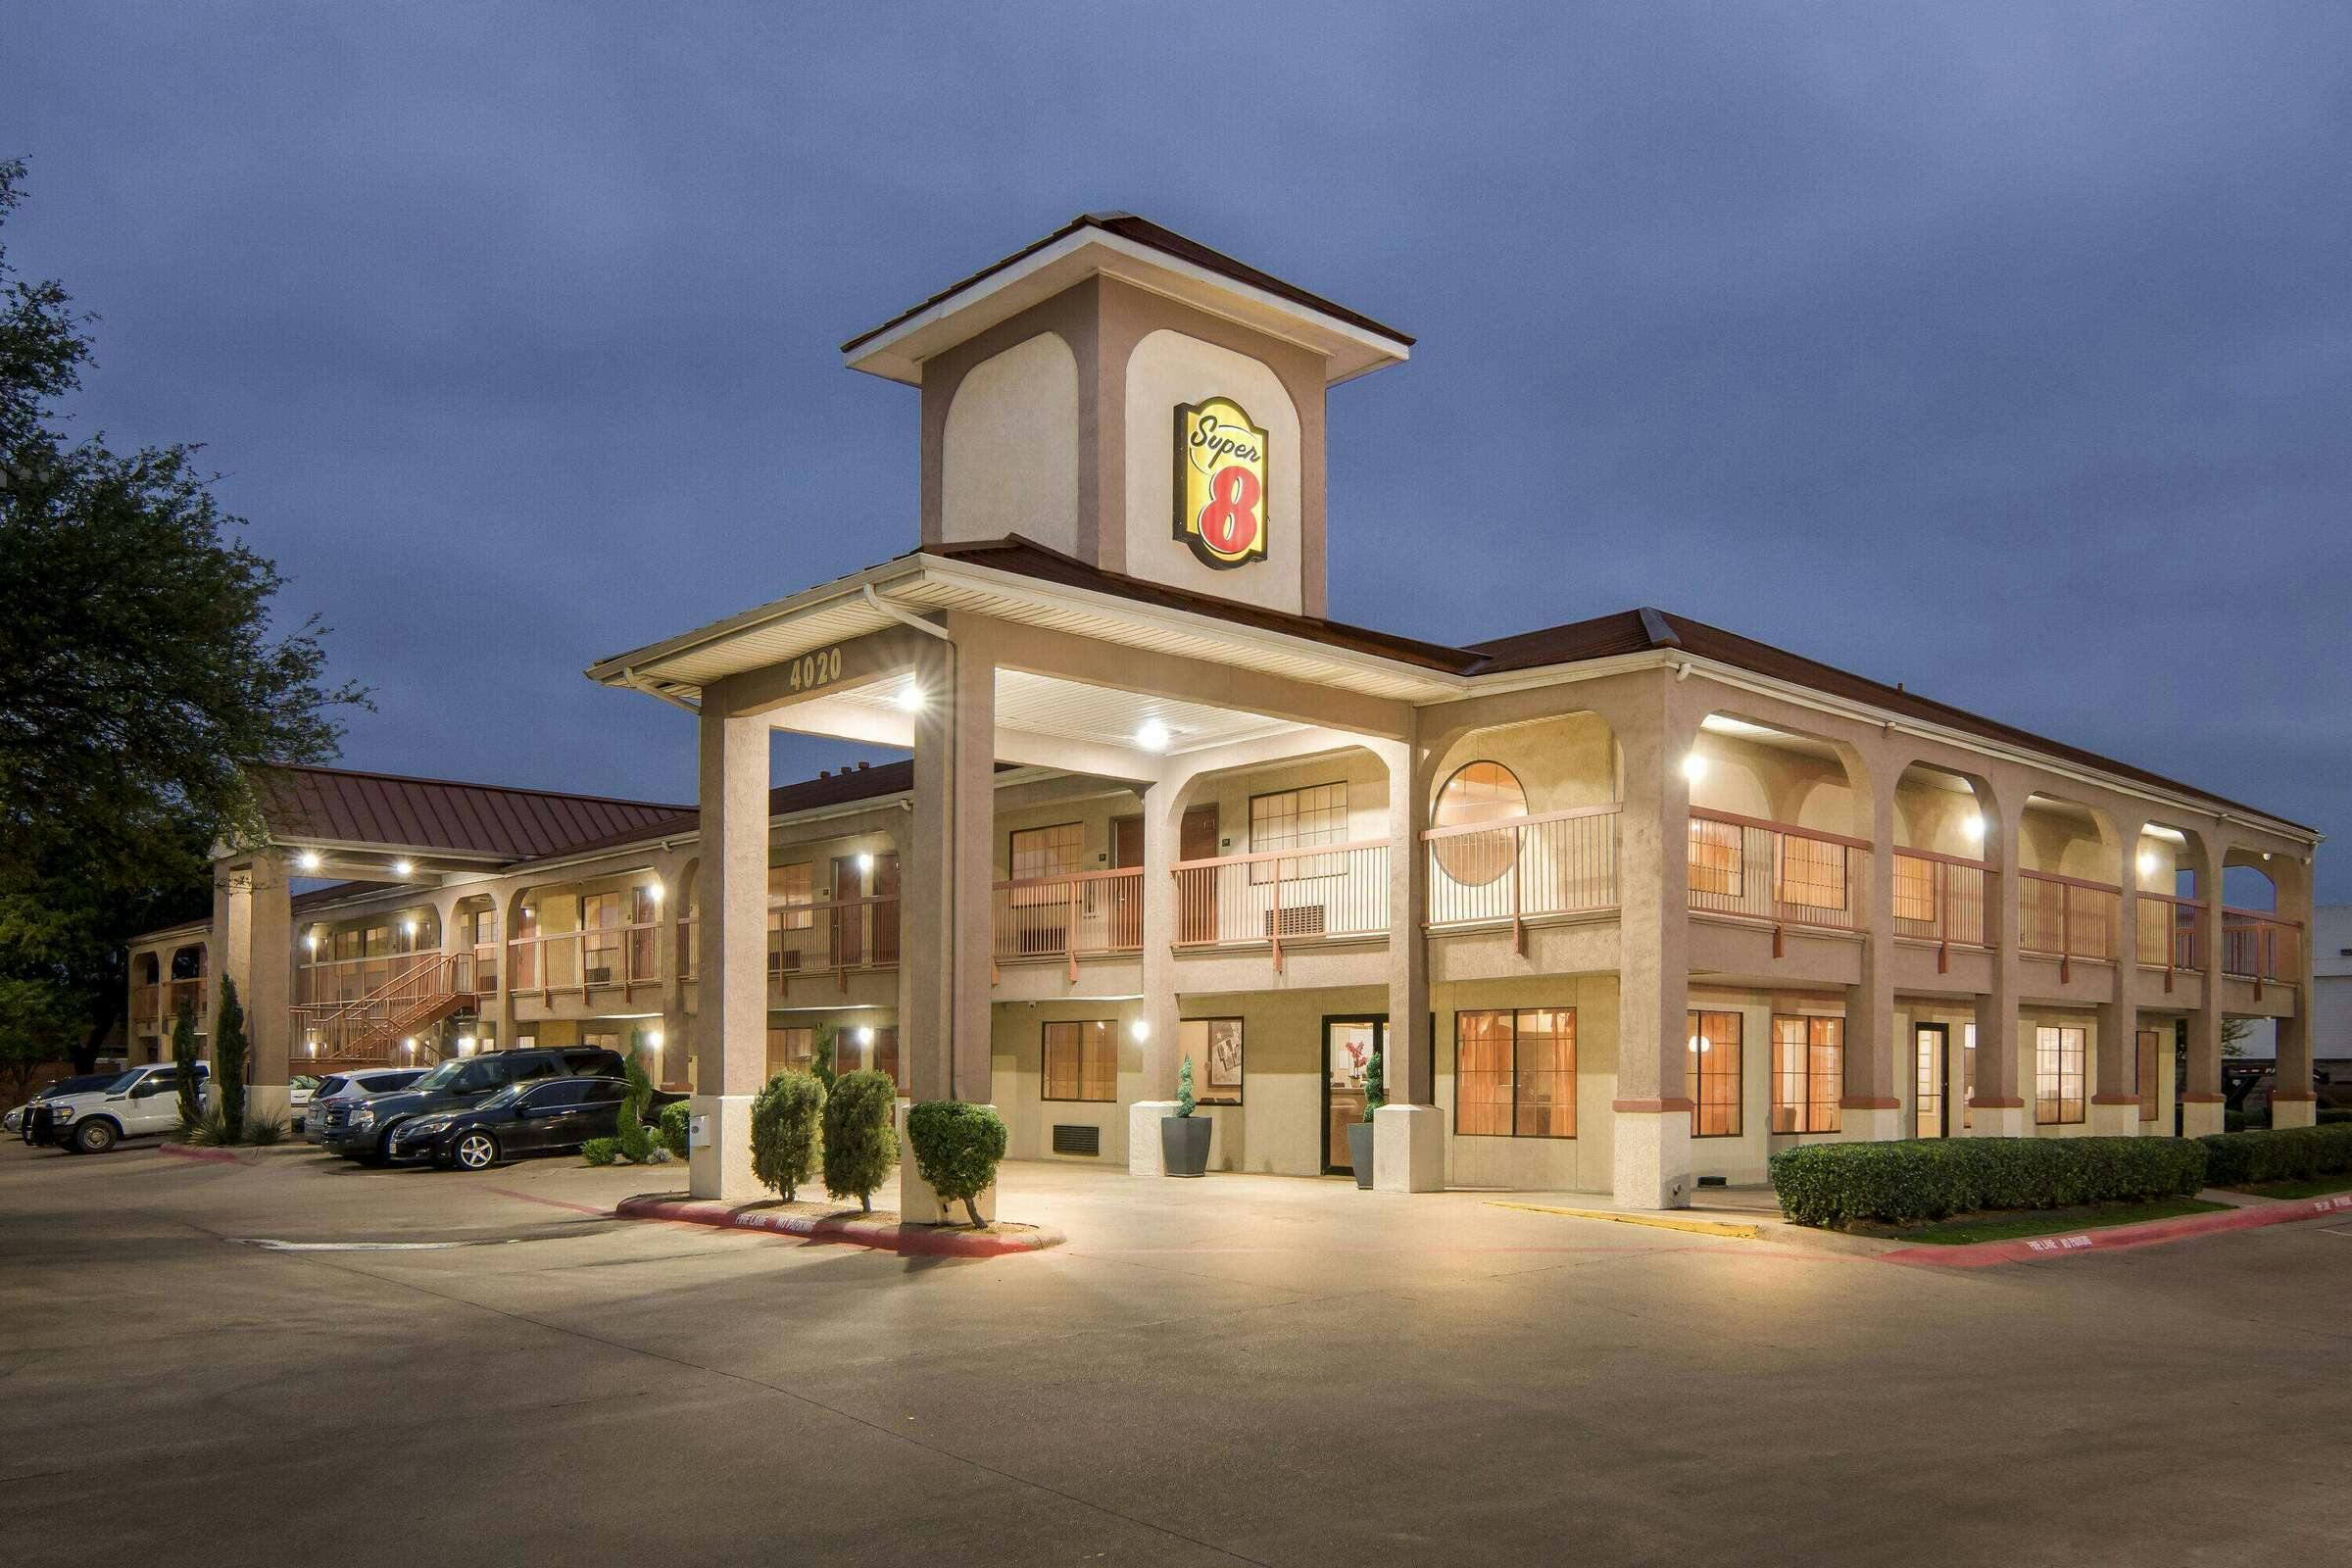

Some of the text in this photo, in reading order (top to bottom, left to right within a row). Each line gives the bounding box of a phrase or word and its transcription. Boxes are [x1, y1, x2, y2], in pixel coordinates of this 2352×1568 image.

[1190, 415, 1261, 468] Super
[1199, 466, 1261, 553] 8
[790, 647, 842, 691] 4020
